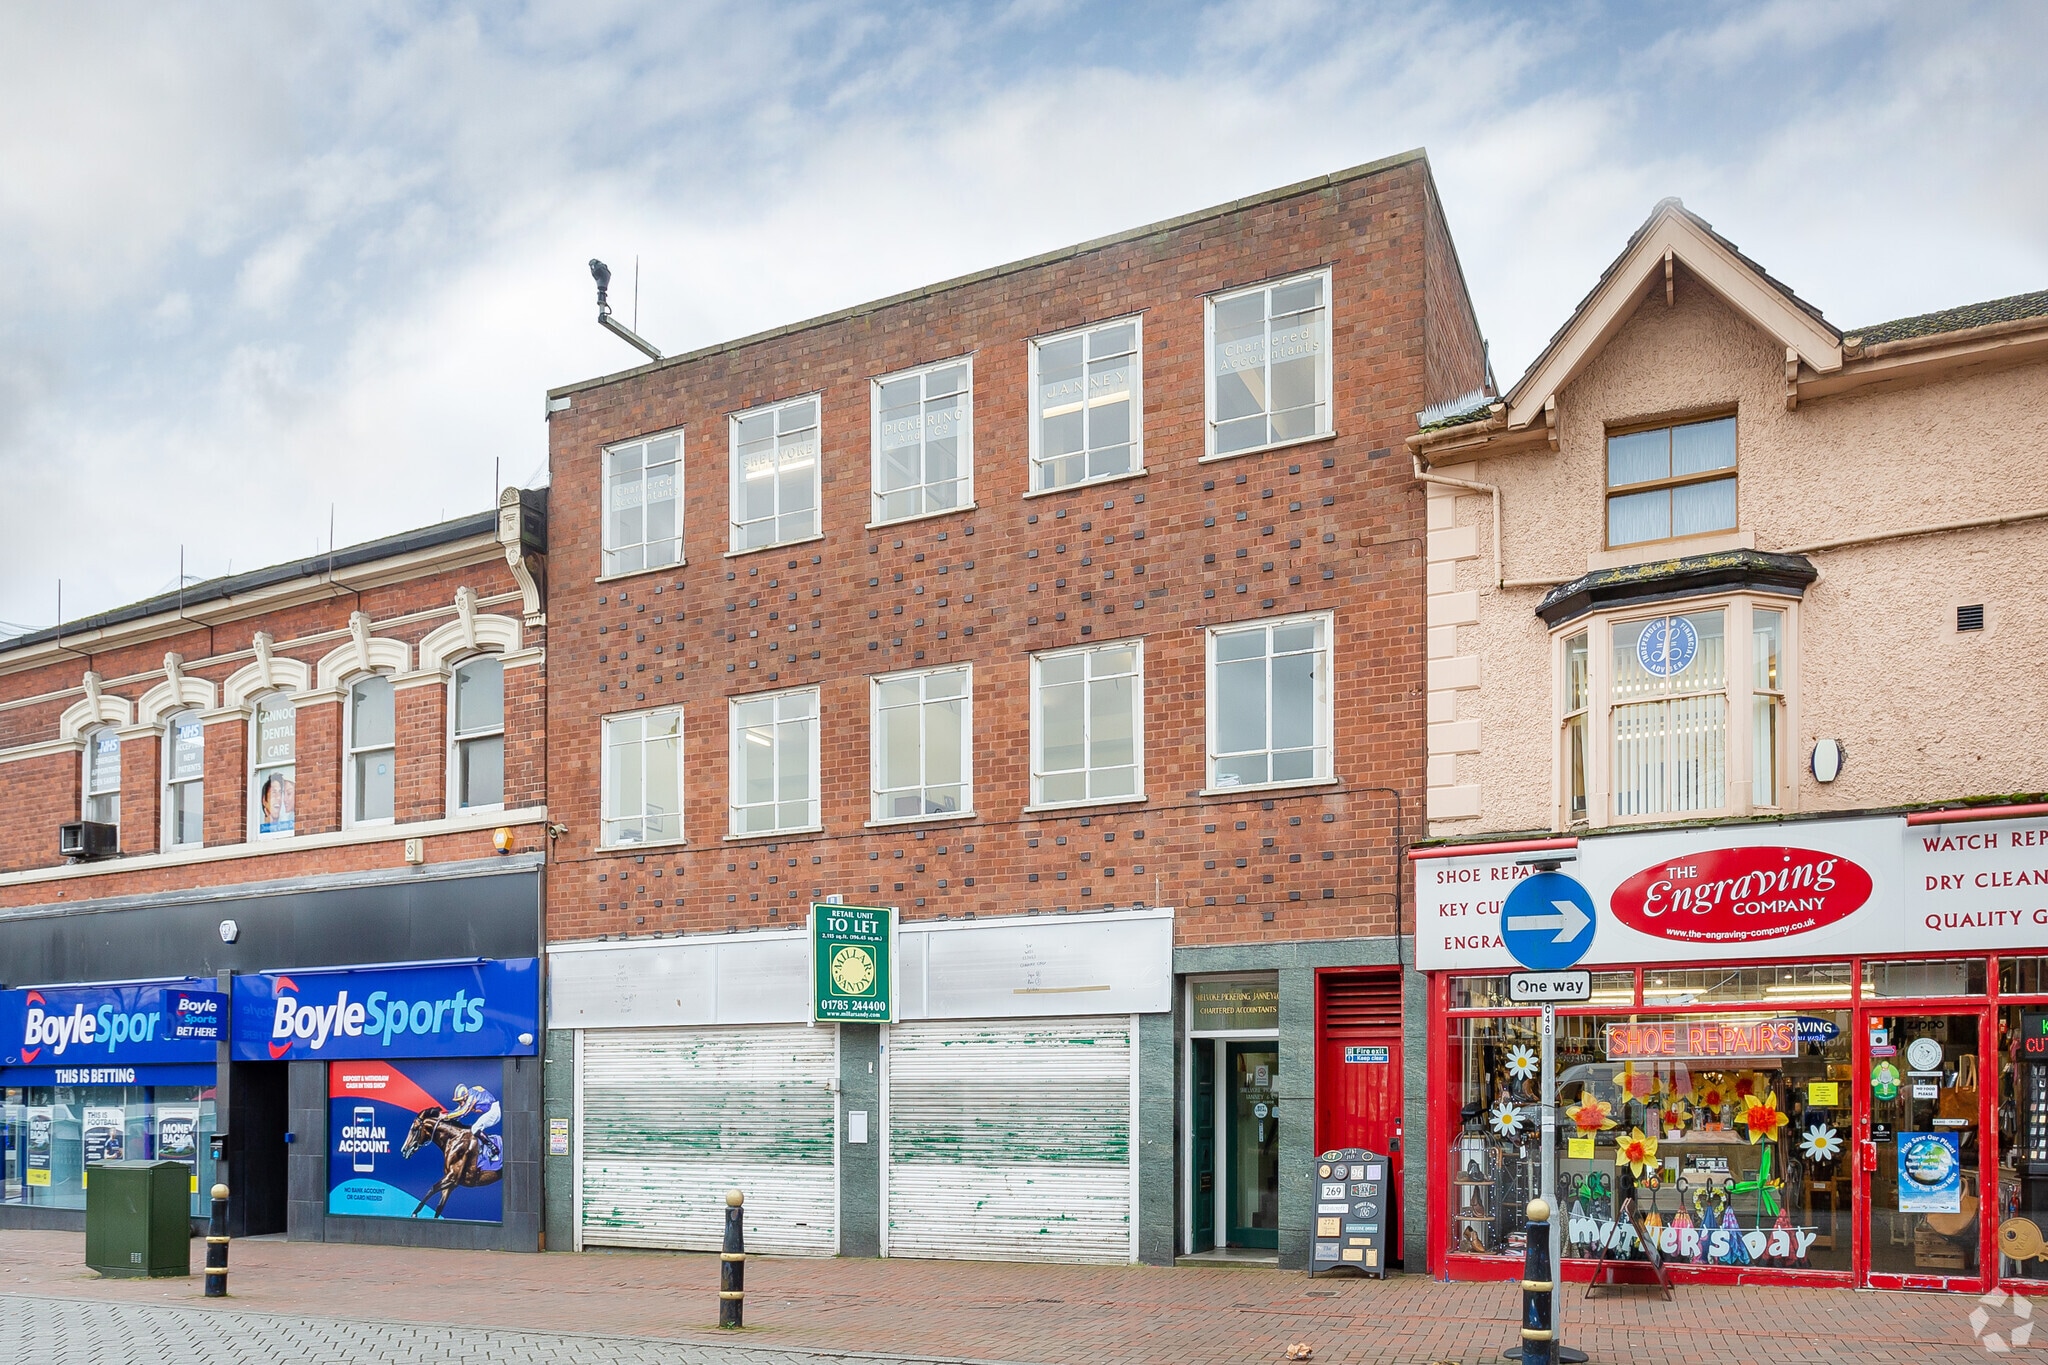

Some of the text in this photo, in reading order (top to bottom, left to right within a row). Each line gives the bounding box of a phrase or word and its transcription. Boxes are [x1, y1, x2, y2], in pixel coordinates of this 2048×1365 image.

[1225, 328, 1309, 356] Chartered
[1047, 371, 1126, 398] JANNEY
[885, 409, 962, 436] PICKERING
[898, 431, 920, 444] And
[1640, 620, 1665, 663] INDEPENDENT
[1680, 622, 1695, 659] FINANCIAL
[1651, 661, 1684, 673] ADVSER
[258, 707, 296, 723] CANNOC
[180, 724, 200, 738] NHS
[263, 725, 295, 740] DENTAL
[100, 740, 118, 753] NHS
[267, 744, 290, 757] CARE
[1922, 833, 1998, 852] WATCH
[1436, 869, 1481, 884] SHOE
[1666, 865, 1697, 880] THE
[1643, 855, 1838, 917] Engraving
[1925, 874, 1965, 891] DRY
[831, 910, 854, 918] RETAIL
[1439, 901, 1504, 917] KEY CU
[1733, 897, 1826, 915] COMPANY
[827, 917, 879, 933] TO LET
[1666, 917, 1816, 939] www.the-engraving-company.co.uk
[1925, 909, 2022, 931] QUALITY
[834, 949, 872, 972] MILLAR
[835, 974, 870, 991] SANDY
[1517, 979, 1584, 994] One way
[178, 998, 218, 1014] Boyle
[821, 999, 886, 1011] 01785 244400
[1200, 1006, 1277, 1014] CHARTERED ACCOUNTANTS
[184, 1014, 217, 1024] Sports
[272, 988, 486, 1050] BoyleSports
[24, 1003, 160, 1055] BoyleSpor
[176, 1026, 218, 1037] BET HERE
[1611, 1028, 1676, 1055] SHOE
[1688, 1025, 1793, 1054] REPAIRS
[1807, 1034, 1826, 1043] wait
[55, 1069, 79, 1084] THIS
[80, 1069, 90, 1083] IS
[162, 1123, 194, 1134] MONEY
[342, 1126, 386, 1139] OPEN AN
[162, 1133, 185, 1144] BACK
[1900, 1142, 1913, 1154] Help
[1911, 1135, 1926, 1143] Save
[1940, 1137, 1957, 1154] Planet
[1327, 1152, 1337, 1160] 67
[1901, 1172, 1919, 1188] Service
[1931, 1182, 1948, 1191] Shoes
[1946, 1172, 1958, 1184] Here
[1325, 1187, 1342, 1196] 269
